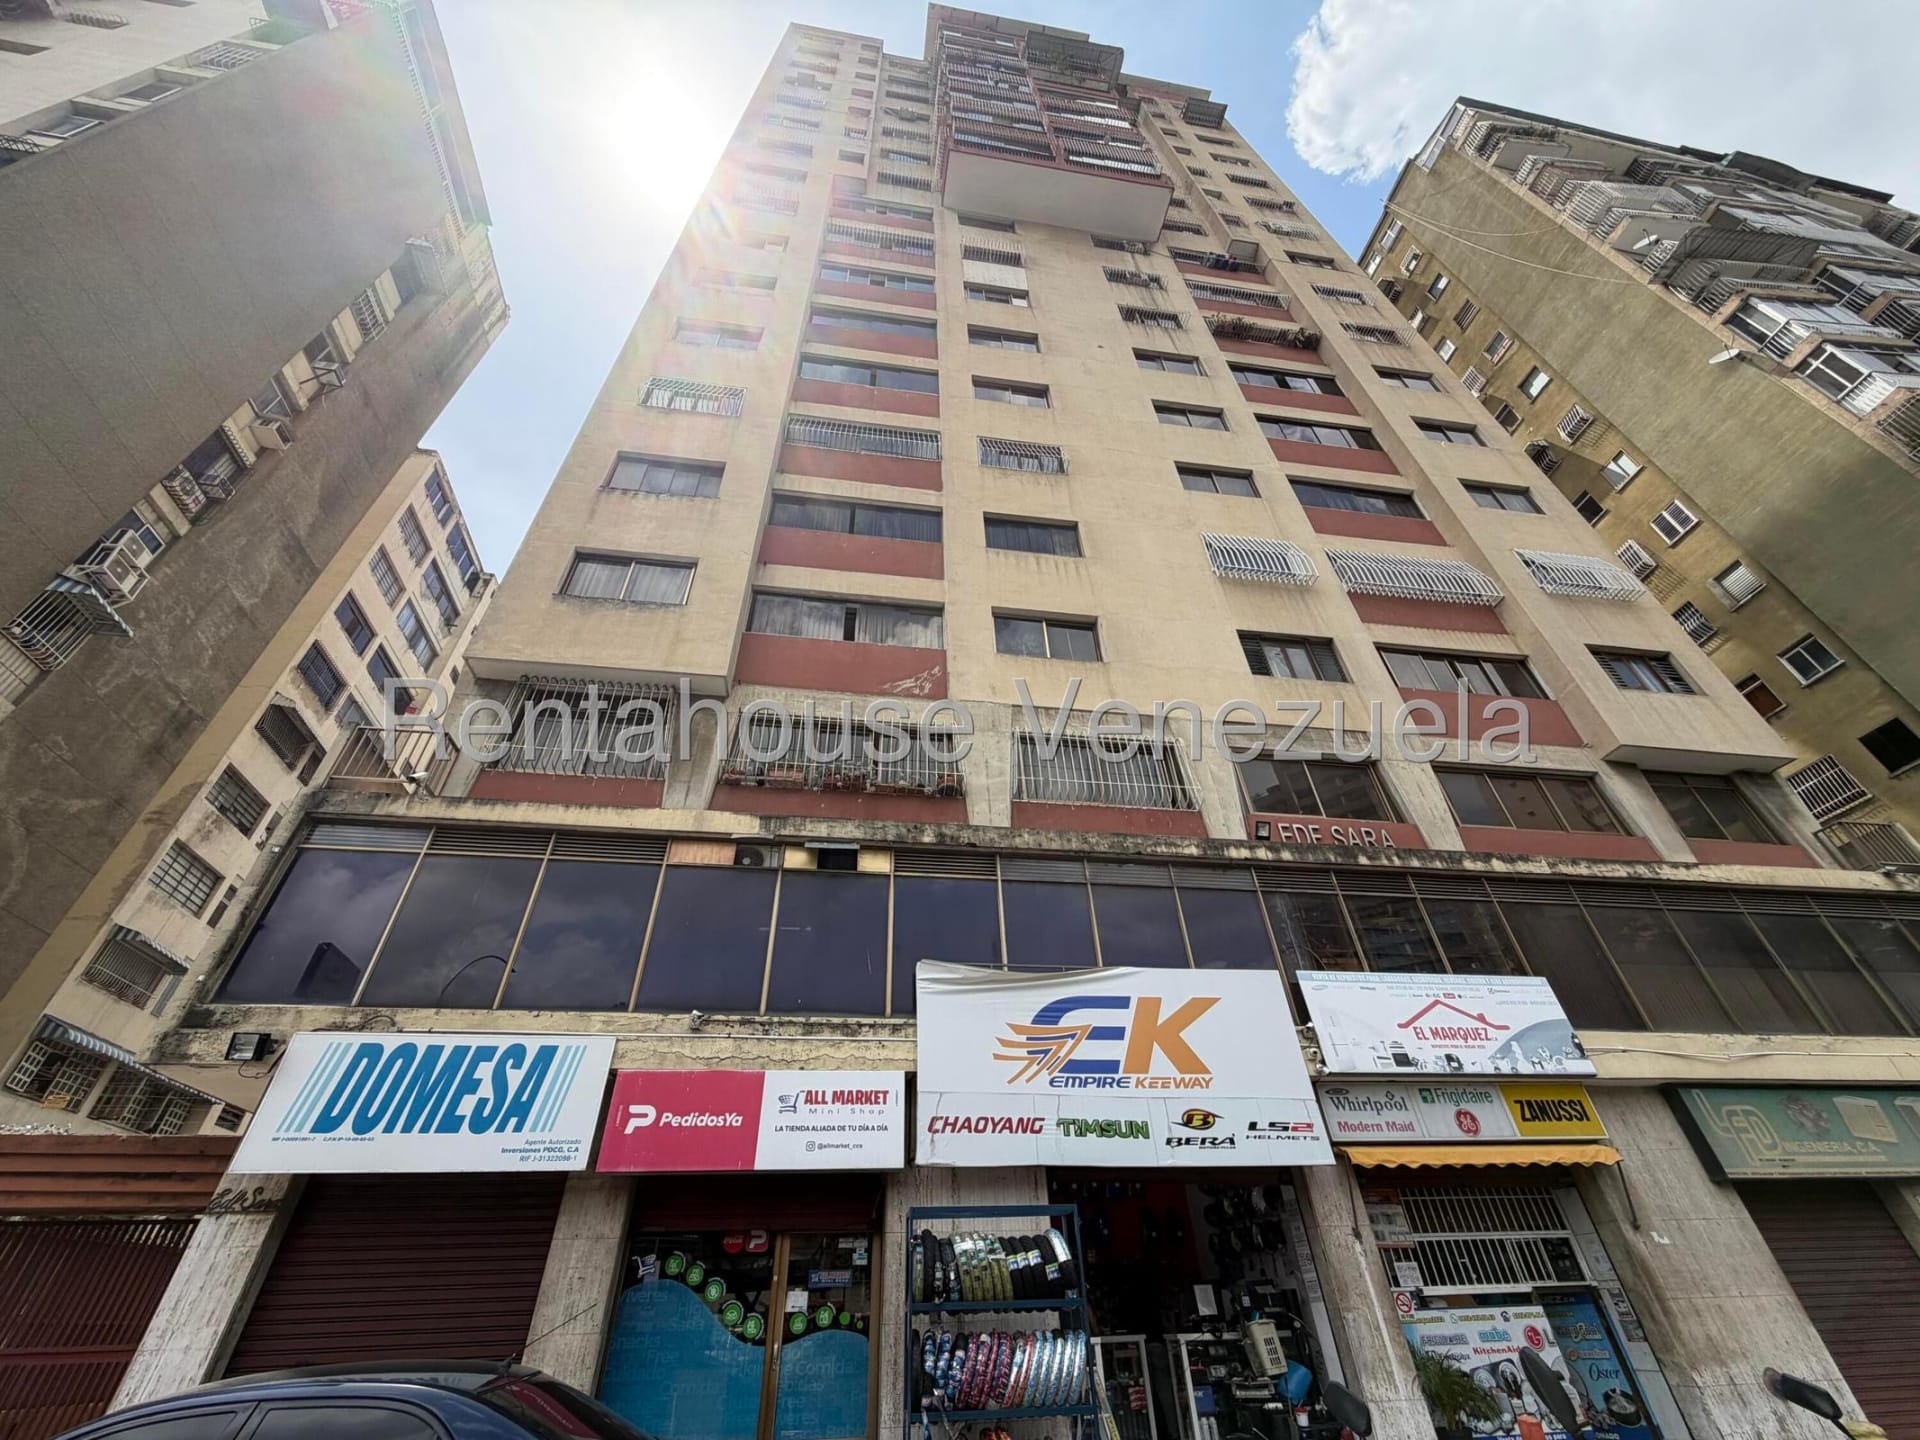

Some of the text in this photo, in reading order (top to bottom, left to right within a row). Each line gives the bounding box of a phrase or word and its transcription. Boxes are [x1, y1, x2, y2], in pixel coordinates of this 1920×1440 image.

[1331, 825, 1397, 848] SARA
[1413, 1026, 1492, 1043] EL MARQUEZ
[309, 1042, 559, 1135] DOMESA
[1049, 1075, 1213, 1089] EMPIRE KEEWAY
[804, 1090, 828, 1105] ALL
[831, 1090, 889, 1105] MARKET
[1328, 1096, 1409, 1116] Whirlpool
[1434, 1087, 1493, 1107] Frigidaire
[659, 1111, 743, 1127] PedidosYa
[1513, 1099, 1591, 1122] ZANUSSI
[927, 1116, 1045, 1134] CHAOYANG
[1057, 1118, 1150, 1139] TIMSUN
[1248, 1121, 1314, 1132] LS2
[1337, 1121, 1416, 1132] Modern Maid
[1589, 1363, 1620, 1381] Oster
